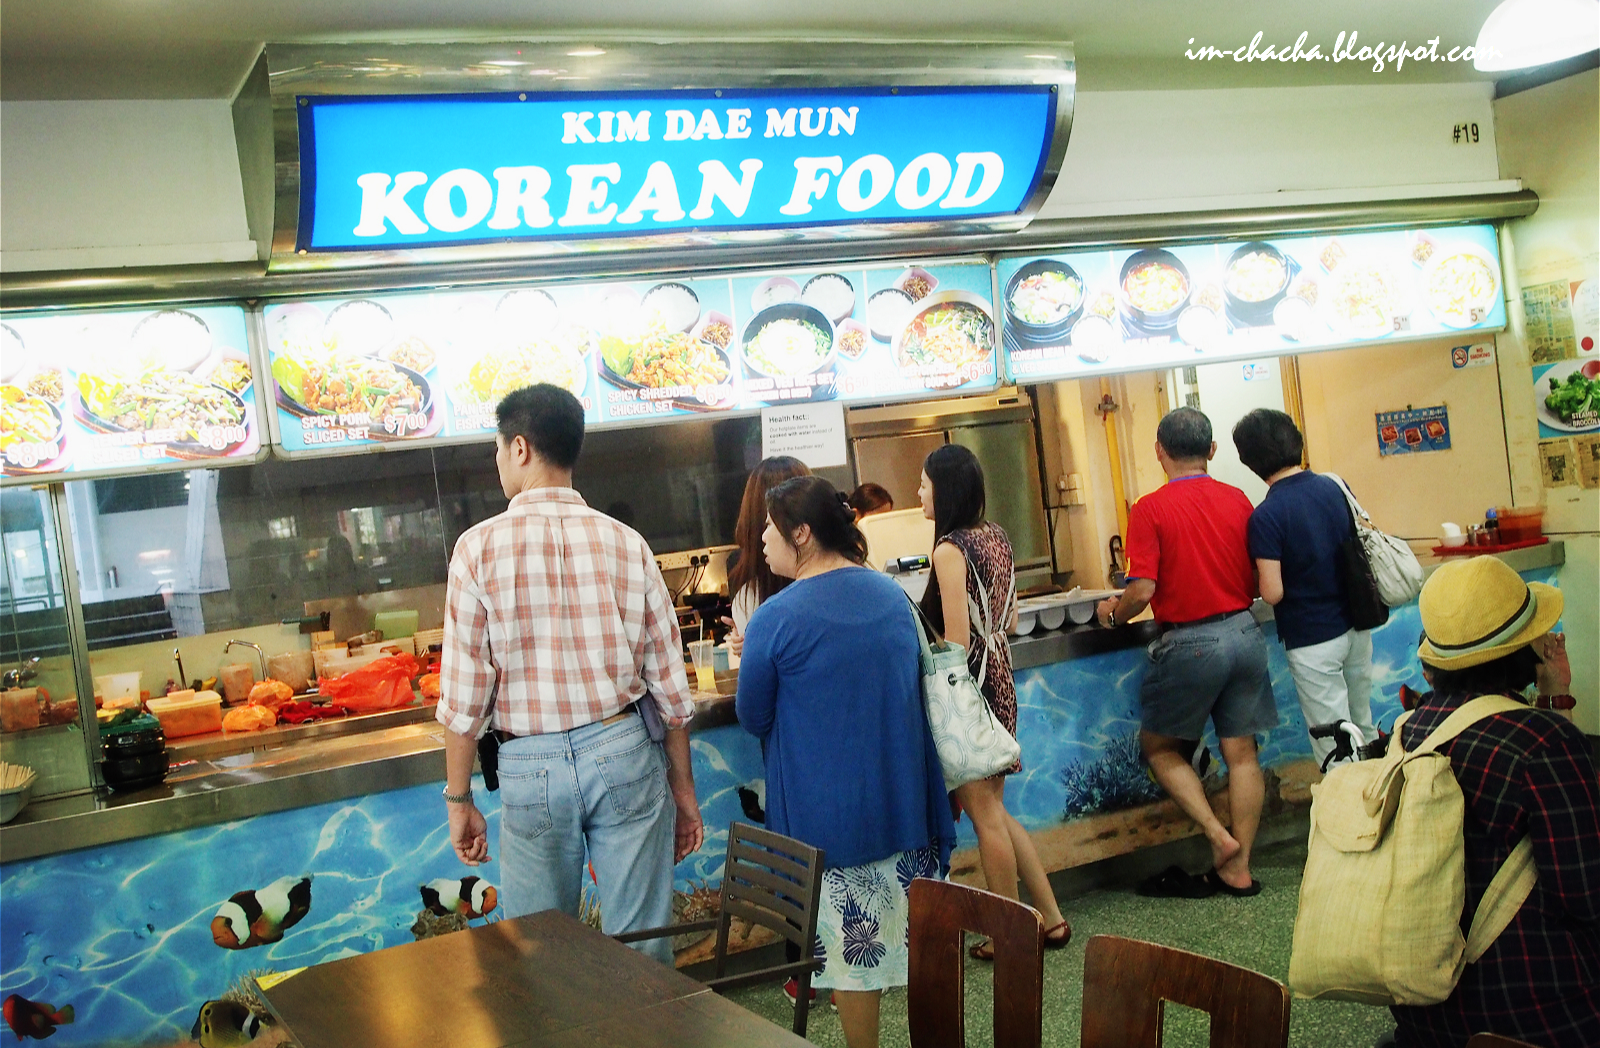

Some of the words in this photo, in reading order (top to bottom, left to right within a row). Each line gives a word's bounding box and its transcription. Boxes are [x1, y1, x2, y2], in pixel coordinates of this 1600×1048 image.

[561, 110, 651, 144] KIM
[663, 108, 751, 141] DAE
[763, 106, 859, 138] MUN
[1453, 123, 1480, 144] #19
[353, 158, 764, 237] KOREAN
[779, 151, 1004, 215] FOOD
[1010, 349, 1042, 361] KOREAN
[1470, 352, 1490, 360] SMOKING
[744, 378, 774, 391] MIXED
[794, 374, 816, 387] RICE
[817, 372, 835, 385] SET
[947, 375, 961, 386] SET
[608, 390, 638, 404] SPICY
[640, 386, 692, 400] SHREDDED
[453, 403, 476, 417] PAN
[478, 401, 499, 415] FRI
[609, 402, 653, 417] CHICKEN
[655, 400, 674, 413] SET
[1571, 410, 1598, 420] STEAMED
[301, 414, 336, 430] SPICY
[340, 411, 372, 426] PORK
[455, 418, 481, 431] FISH
[482, 415, 497, 429] SE
[768, 415, 791, 423] Health
[89, 431, 144, 449] TENDER
[145, 429, 178, 444] BEEF
[303, 429, 345, 444] SLICED
[348, 427, 370, 441] SET
[93, 447, 139, 464] SLICED
[142, 444, 167, 459] SET
